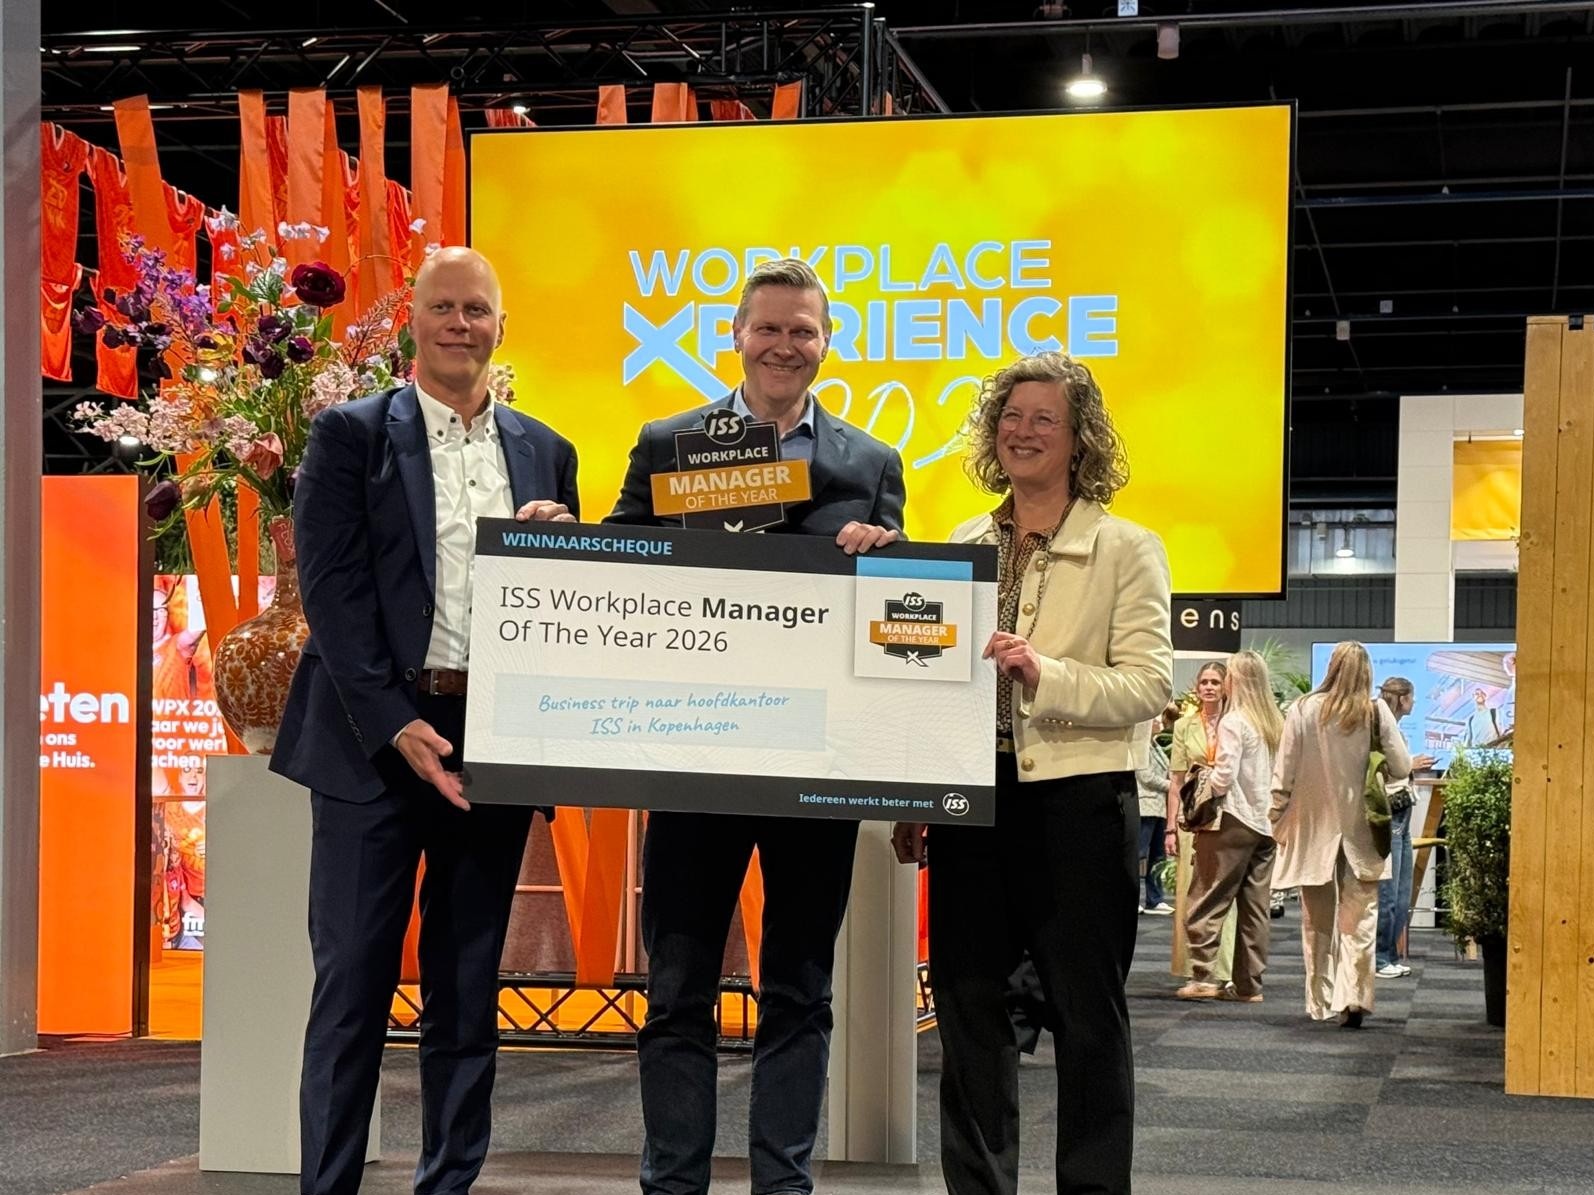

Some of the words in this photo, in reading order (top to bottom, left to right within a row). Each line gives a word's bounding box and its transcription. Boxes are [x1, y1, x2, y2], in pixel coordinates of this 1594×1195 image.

[623, 295, 1118, 402] XPRIENCE
[688, 446, 769, 465] WORKPLACE
[669, 466, 792, 496] MANAGER
[686, 496, 705, 509] OF
[710, 491, 737, 507] THE
[740, 488, 778, 503] YEAR
[502, 532, 672, 556] WINNAARSCHEQUE
[500, 586, 541, 609] ISS
[550, 589, 692, 620] Workplace
[702, 597, 829, 629] Manager
[891, 612, 937, 621] WORKPLACE
[499, 620, 533, 642] Of
[539, 621, 588, 645] The
[597, 625, 657, 648] Year
[665, 628, 728, 652] 2026
[880, 623, 948, 637] MANAGER
[887, 634, 900, 643] OF
[901, 635, 919, 644] THE
[920, 636, 939, 645] YEAR
[538, 695, 605, 712] Business
[611, 695, 639, 714] trip
[645, 697, 682, 709] naar
[687, 691, 789, 709] hoofdkantoor
[183, 720, 208, 733] we
[589, 716, 623, 736] ISS
[627, 719, 642, 733] in
[648, 716, 740, 735] Kopenhagen
[45, 733, 77, 746] ons
[53, 751, 96, 768] Huis.
[799, 793, 846, 805] Iedereen
[848, 796, 879, 806] werkt
[882, 797, 910, 808] beter
[912, 799, 934, 809] met
